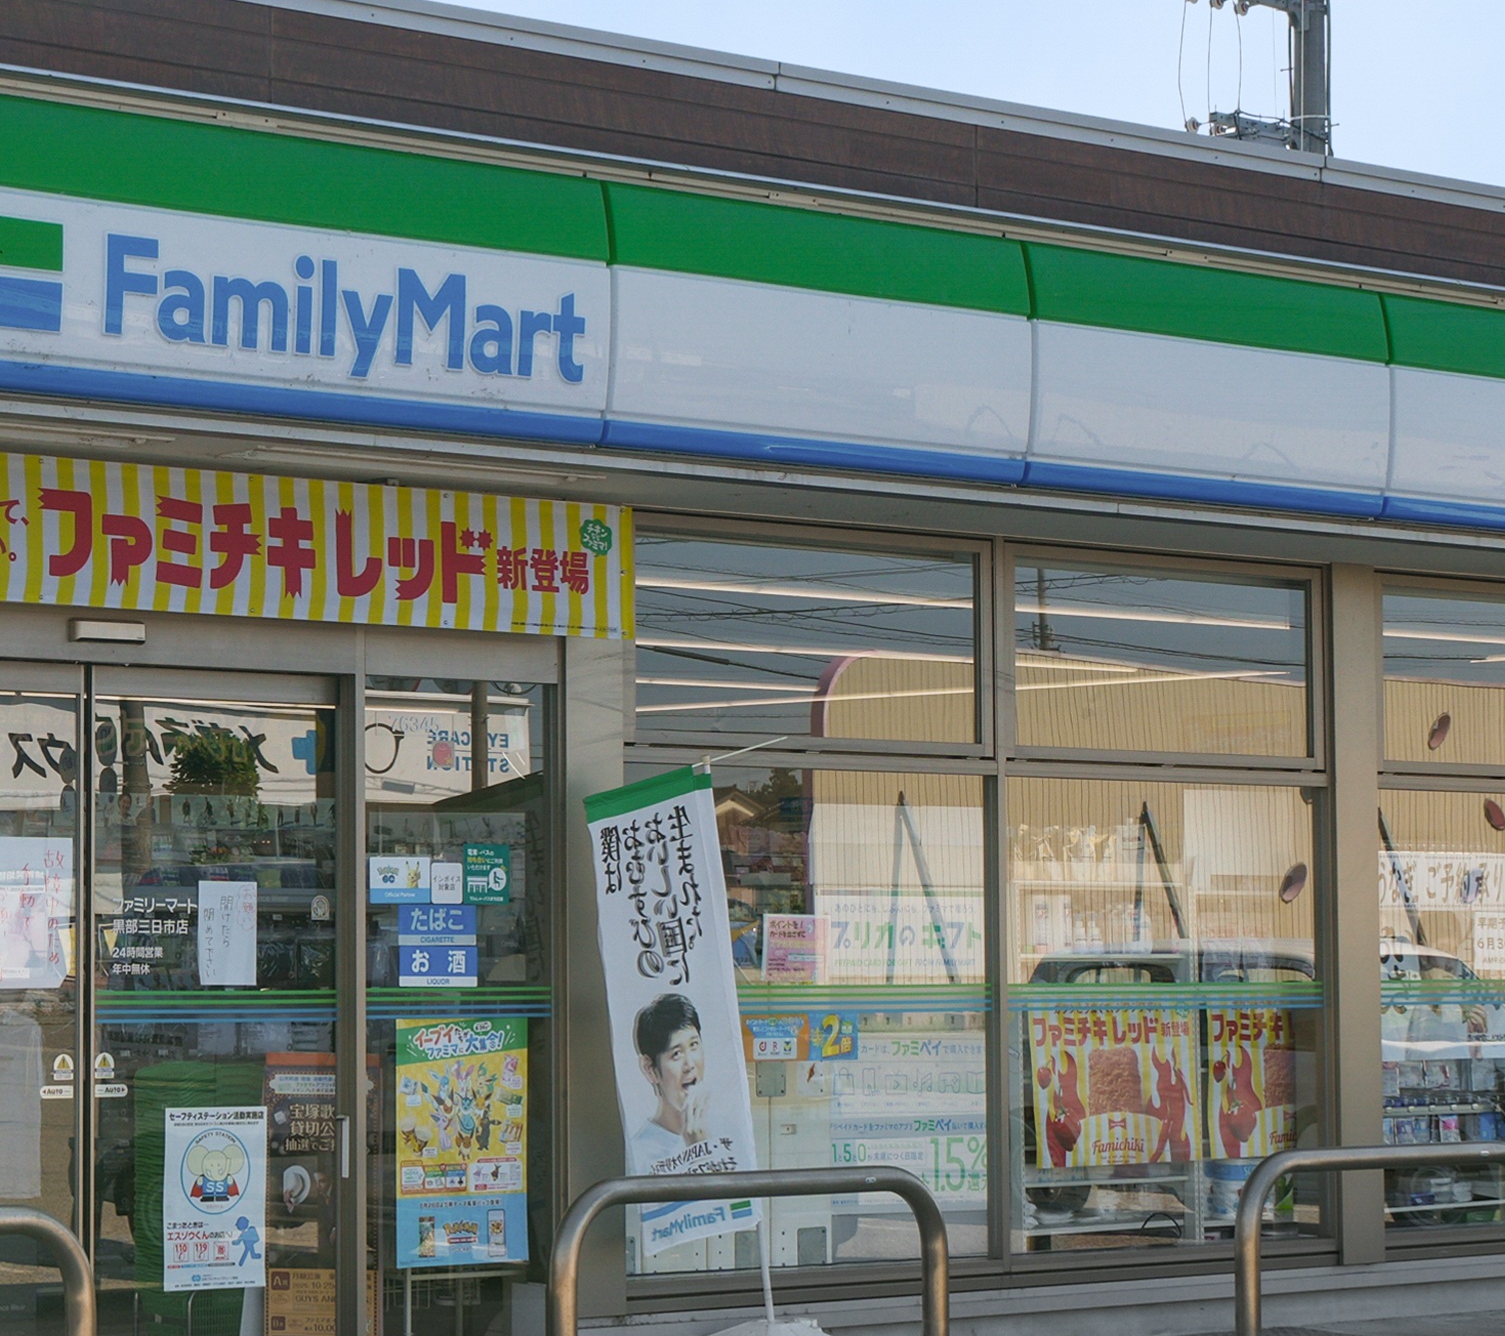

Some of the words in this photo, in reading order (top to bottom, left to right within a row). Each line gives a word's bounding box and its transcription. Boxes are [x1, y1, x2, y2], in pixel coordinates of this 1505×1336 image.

[104, 233, 587, 384] FamilyMart
[38, 487, 494, 605] ファミチキレッド
[496, 546, 590, 595] 新登場
[43, 849, 65, 965] 故障中のため
[112, 897, 198, 914] ファミリーマート
[112, 919, 189, 935] 黒部三日市店
[219, 895, 234, 949] 開けたら
[411, 907, 464, 931] たばこ
[203, 908, 216, 977] 閉めて下さい
[112, 947, 163, 959] 24時間営業
[112, 963, 150, 975] 年中無休
[1032, 1016, 1159, 1047] ファミチキレッド
[1160, 1021, 1190, 1038] 新登場
[290, 1104, 335, 1119] 宝塚歌
[289, 1121, 335, 1137] 貸切公
[1092, 1136, 1145, 1155] Famichiki
[206, 1182, 224, 1193] SS
